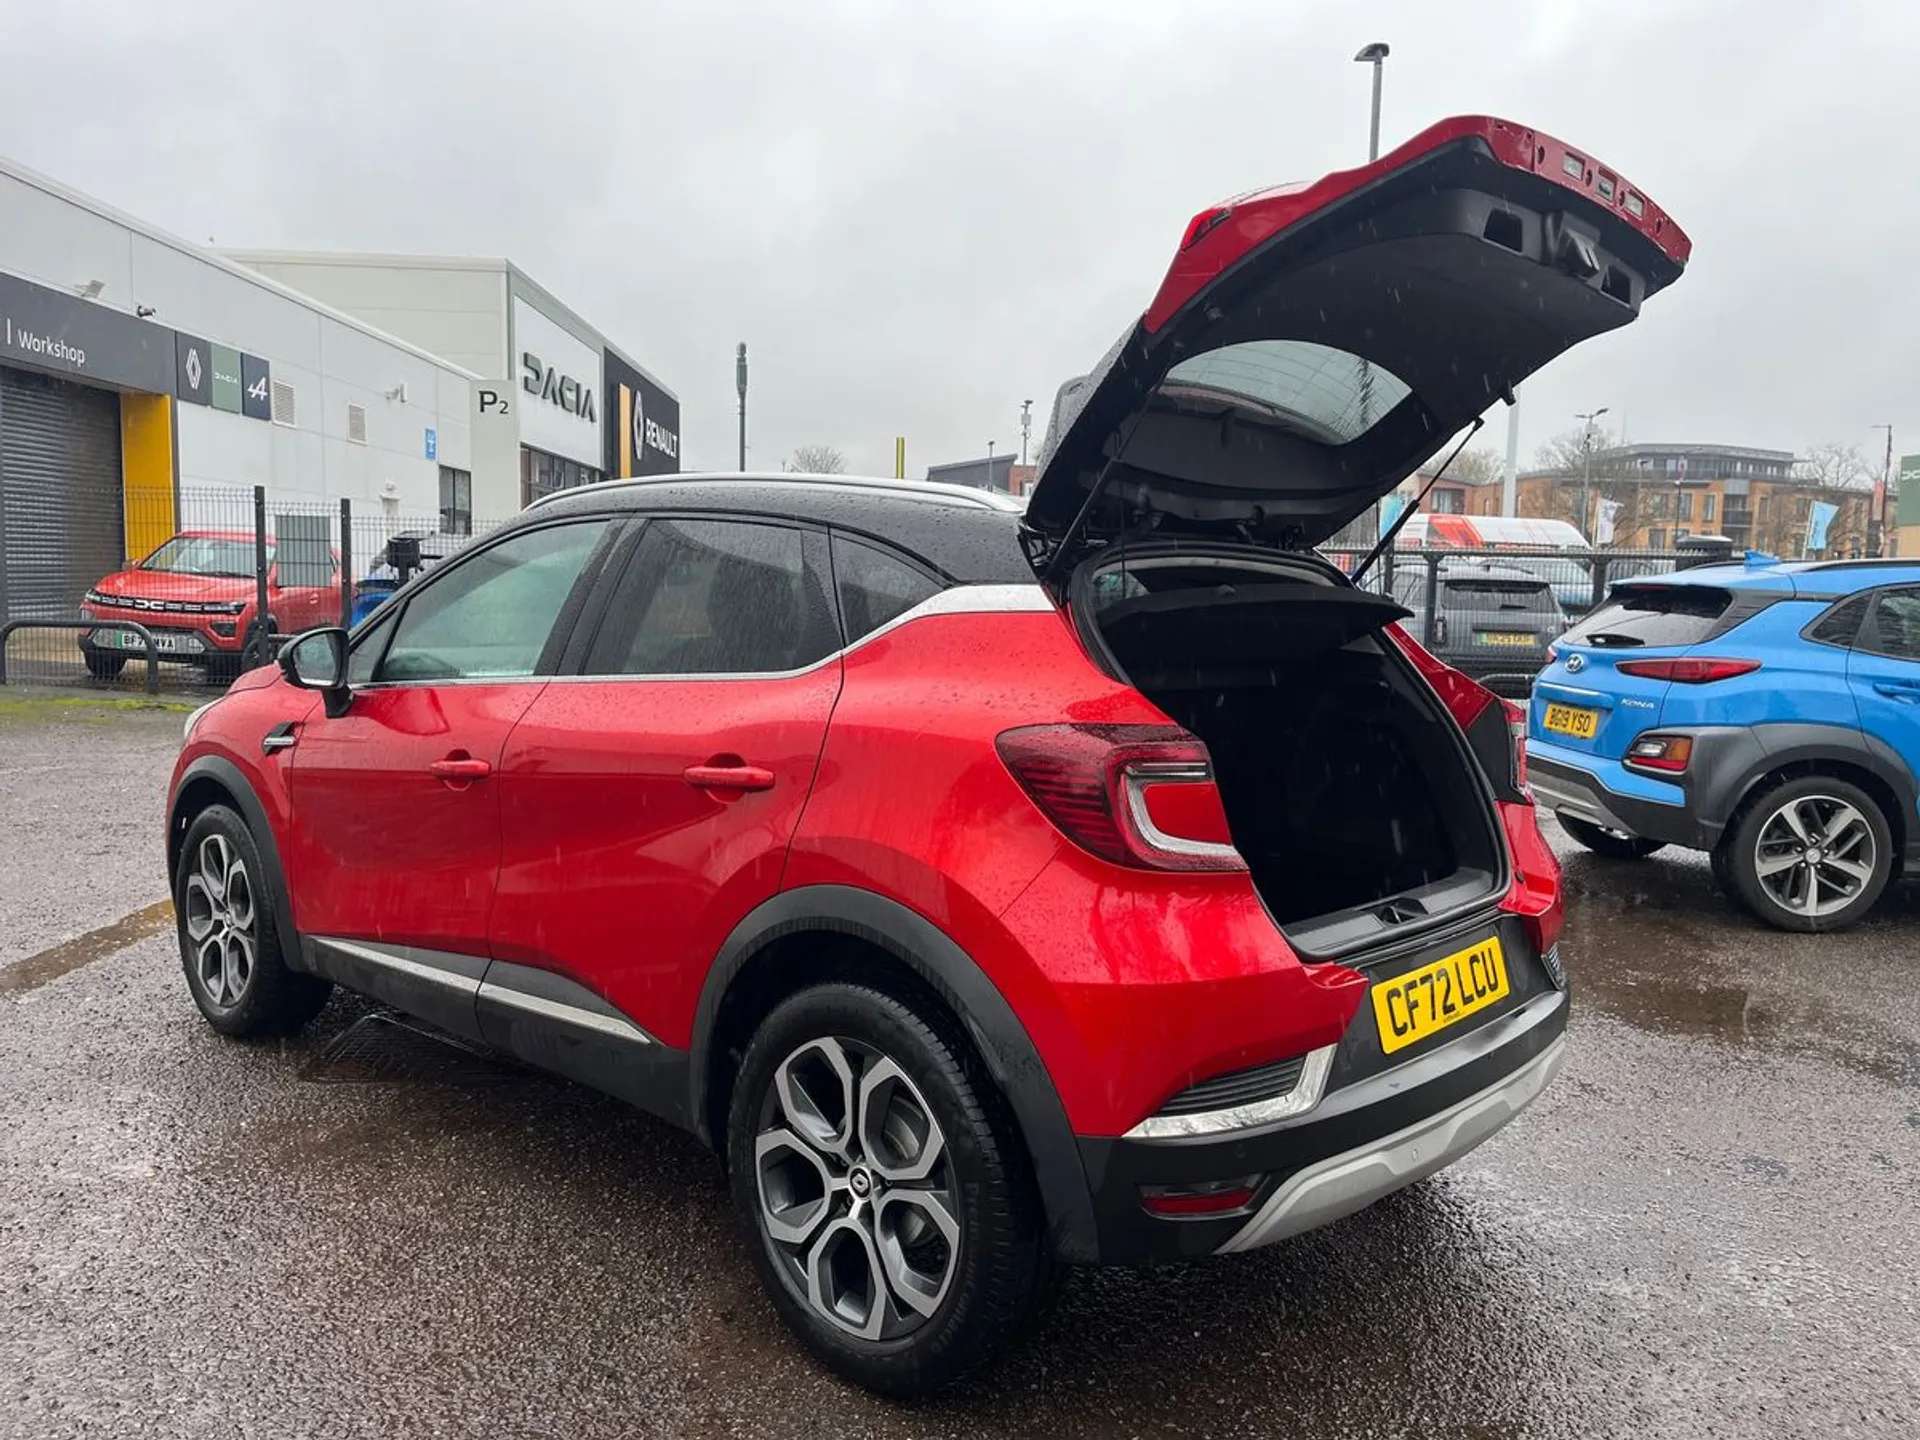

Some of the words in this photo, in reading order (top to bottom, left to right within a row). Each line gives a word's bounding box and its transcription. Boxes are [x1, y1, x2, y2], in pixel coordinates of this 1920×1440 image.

[18, 328, 85, 367] Workshop
[523, 352, 597, 423] DACIA
[646, 417, 677, 459] RENAULT
[1571, 711, 1592, 733] YSO
[1621, 698, 1655, 709] KONA
[1386, 966, 1456, 1037] CF72
[1455, 947, 1499, 1007] LCU
